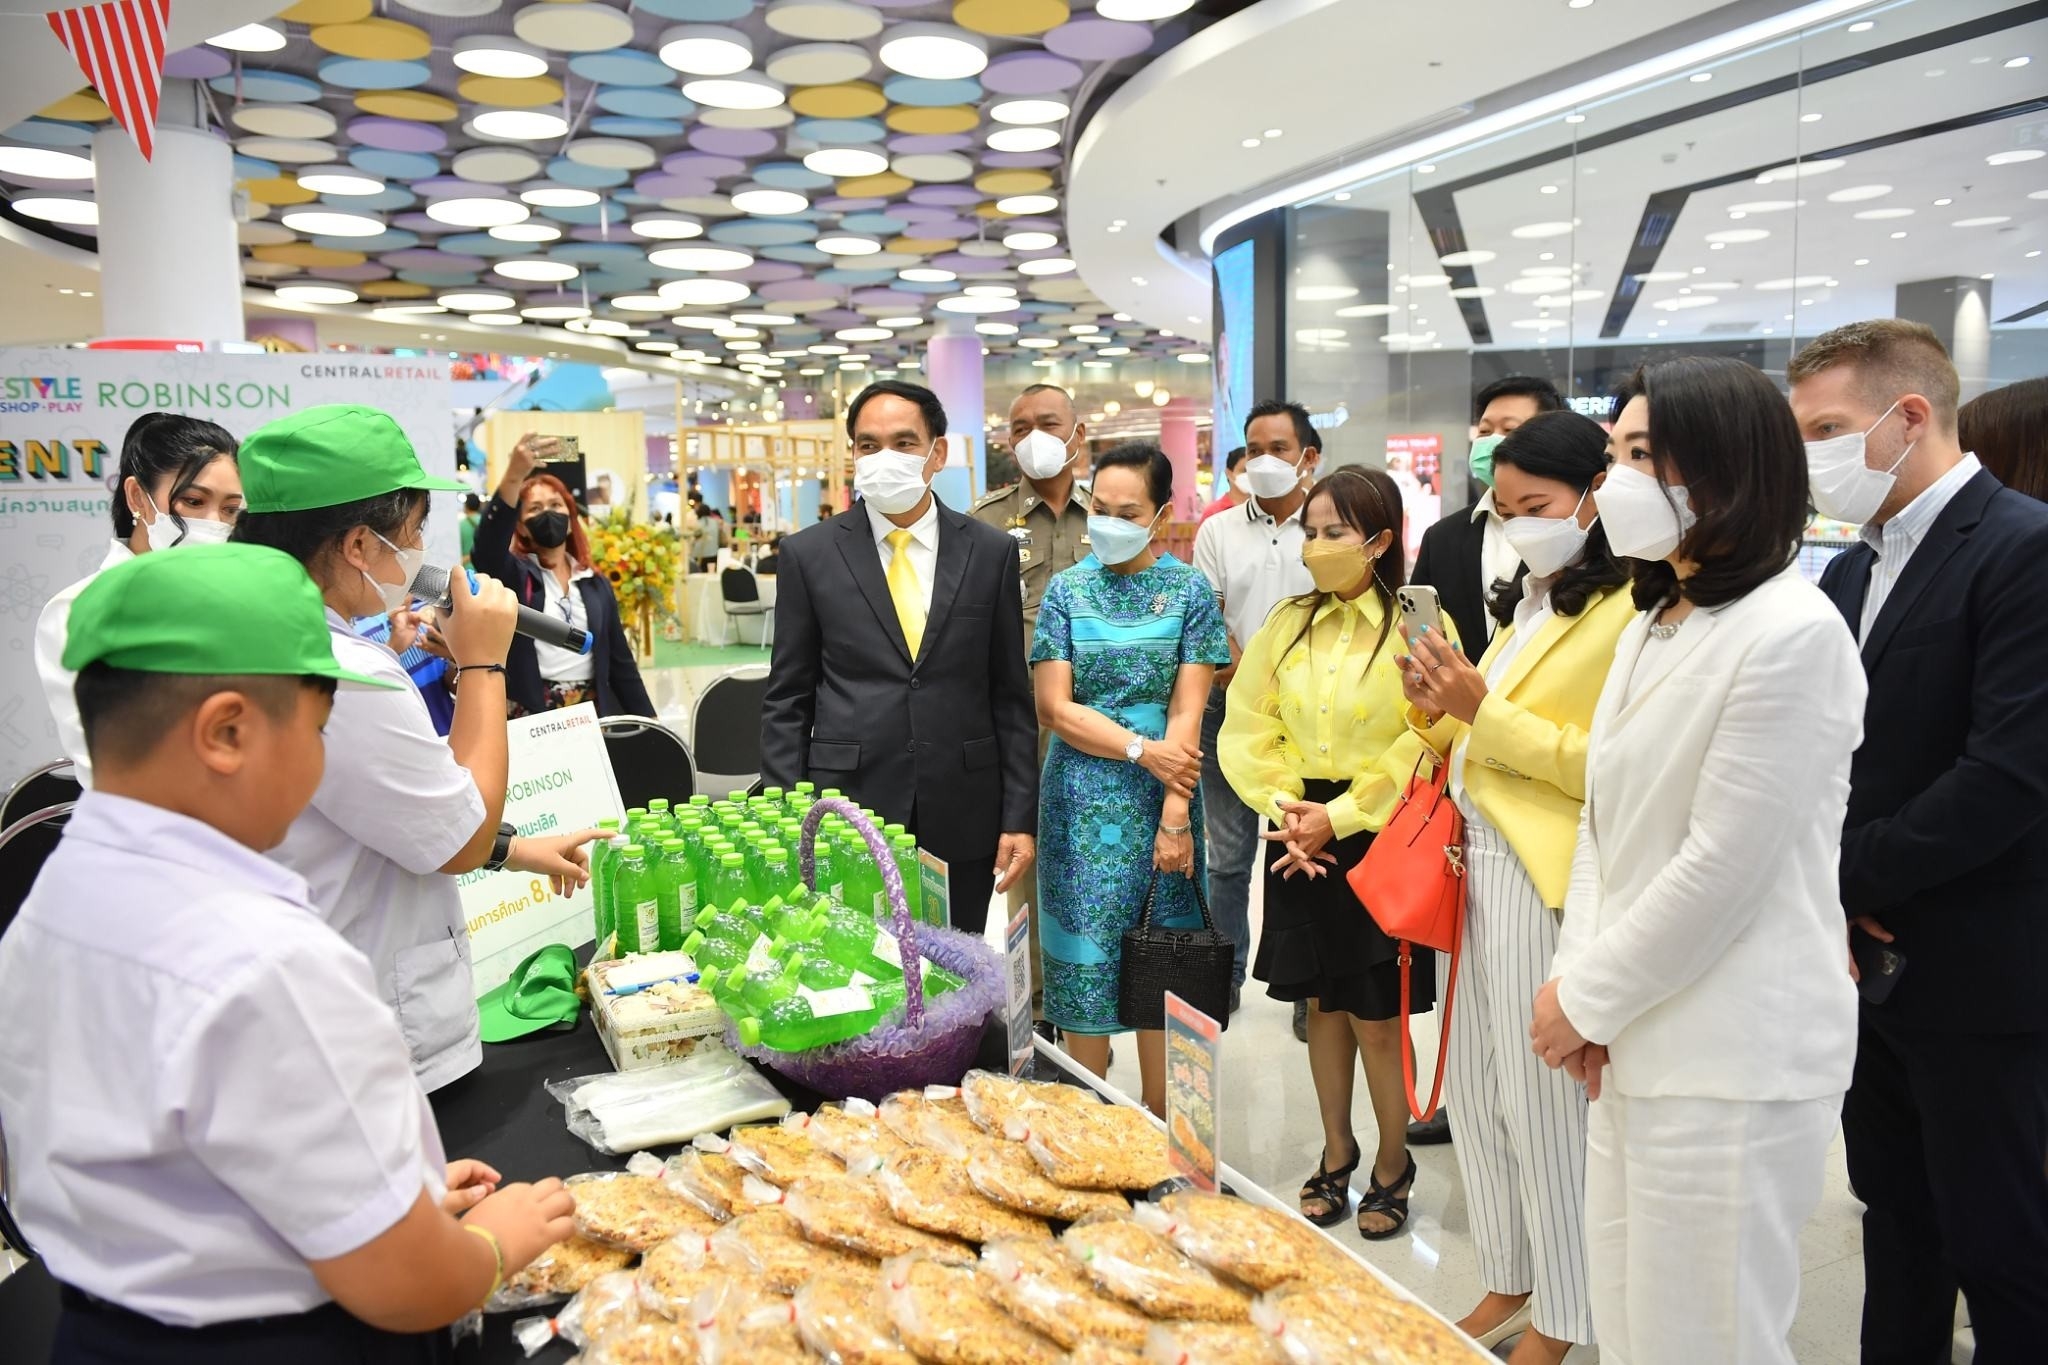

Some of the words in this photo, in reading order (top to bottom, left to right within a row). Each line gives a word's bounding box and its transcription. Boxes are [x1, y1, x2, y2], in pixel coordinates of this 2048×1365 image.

[301, 365, 441, 379] CENTRALRETAIL
[98, 382, 290, 408] ROBINSON
[0, 402, 39, 413] SHOP
[48, 402, 82, 413] PLAY
[530, 715, 592, 738] CENTRALRETAIL
[505, 769, 573, 804] ROBINSON
